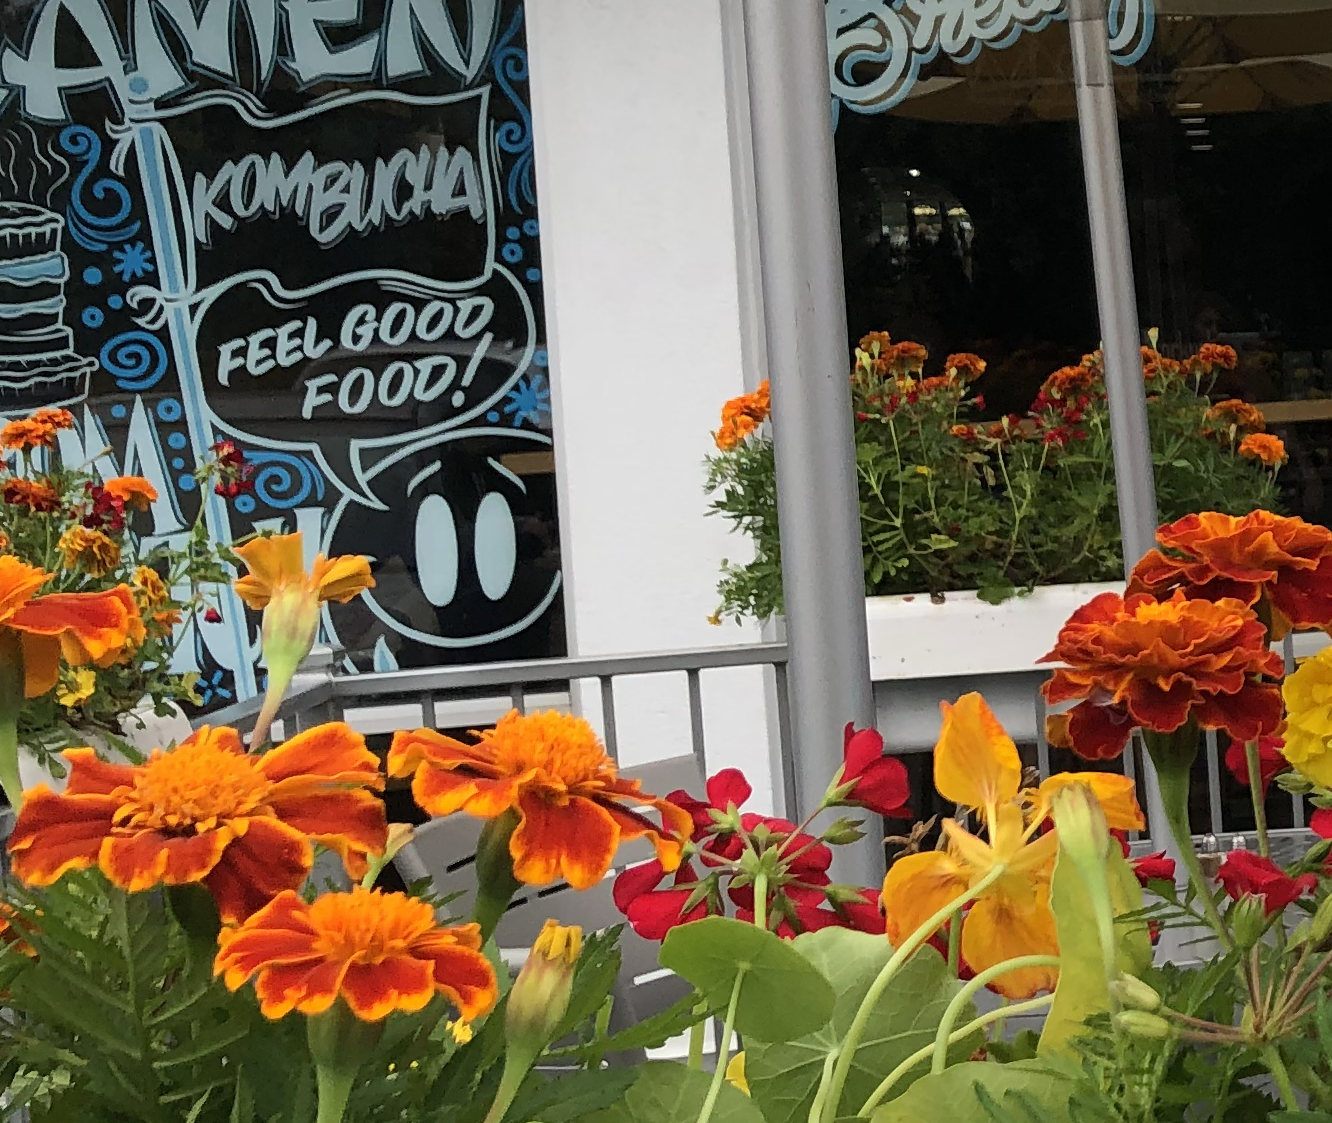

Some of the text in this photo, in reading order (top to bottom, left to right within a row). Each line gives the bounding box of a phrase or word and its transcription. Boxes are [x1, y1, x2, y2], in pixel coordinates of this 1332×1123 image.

[194, 144, 486, 250] KOMBUCHA
[217, 295, 494, 386] FEEL GOOD
[302, 331, 494, 419] FOOD!
